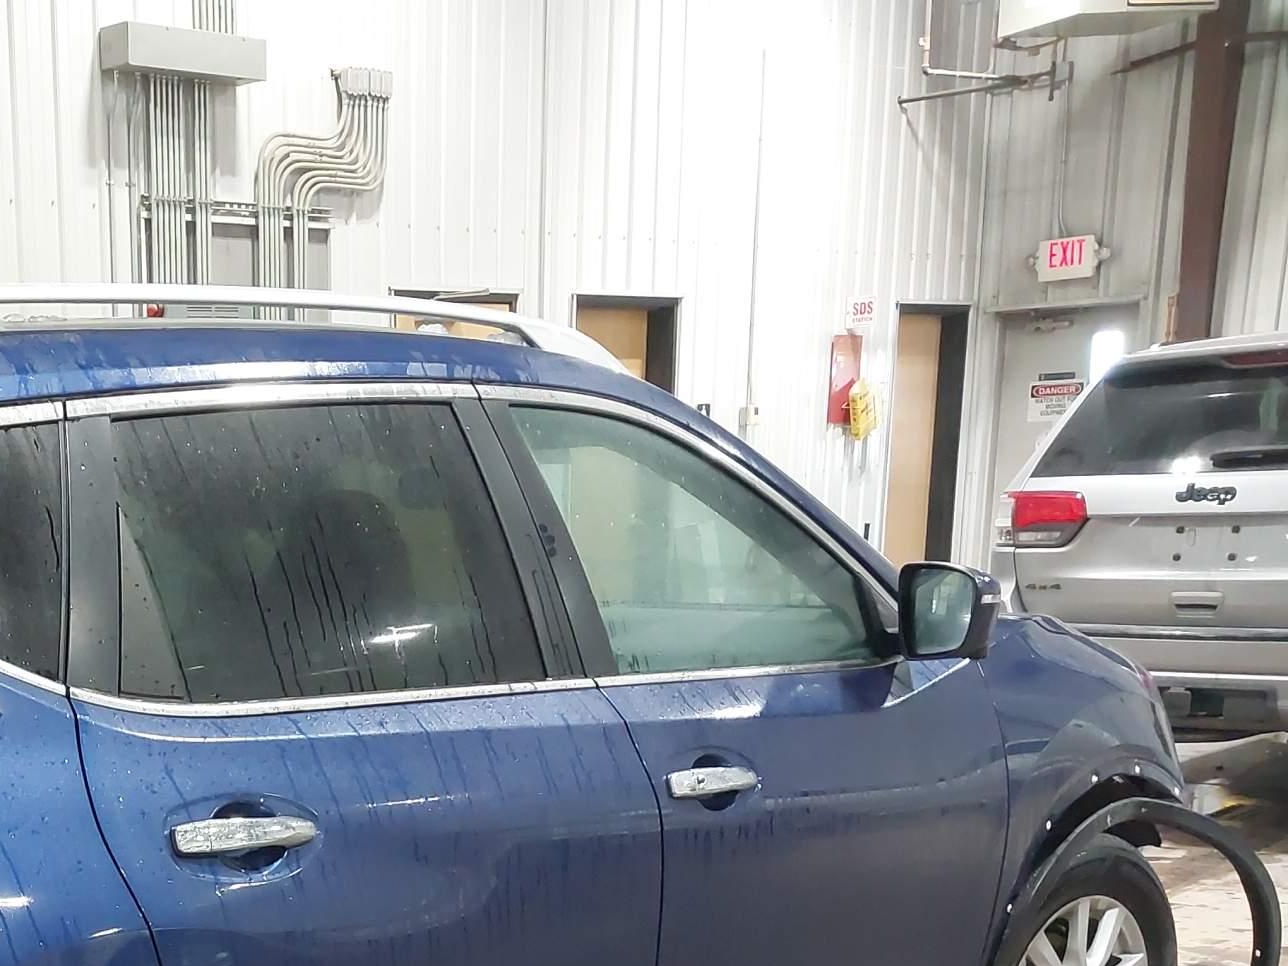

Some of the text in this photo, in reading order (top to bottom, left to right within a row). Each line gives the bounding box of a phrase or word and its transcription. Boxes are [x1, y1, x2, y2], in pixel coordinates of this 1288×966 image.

[1049, 239, 1086, 268] EXIT
[853, 301, 874, 316] SDS
[1038, 385, 1076, 395] DANGER
[1175, 482, 1237, 505] Jeep
